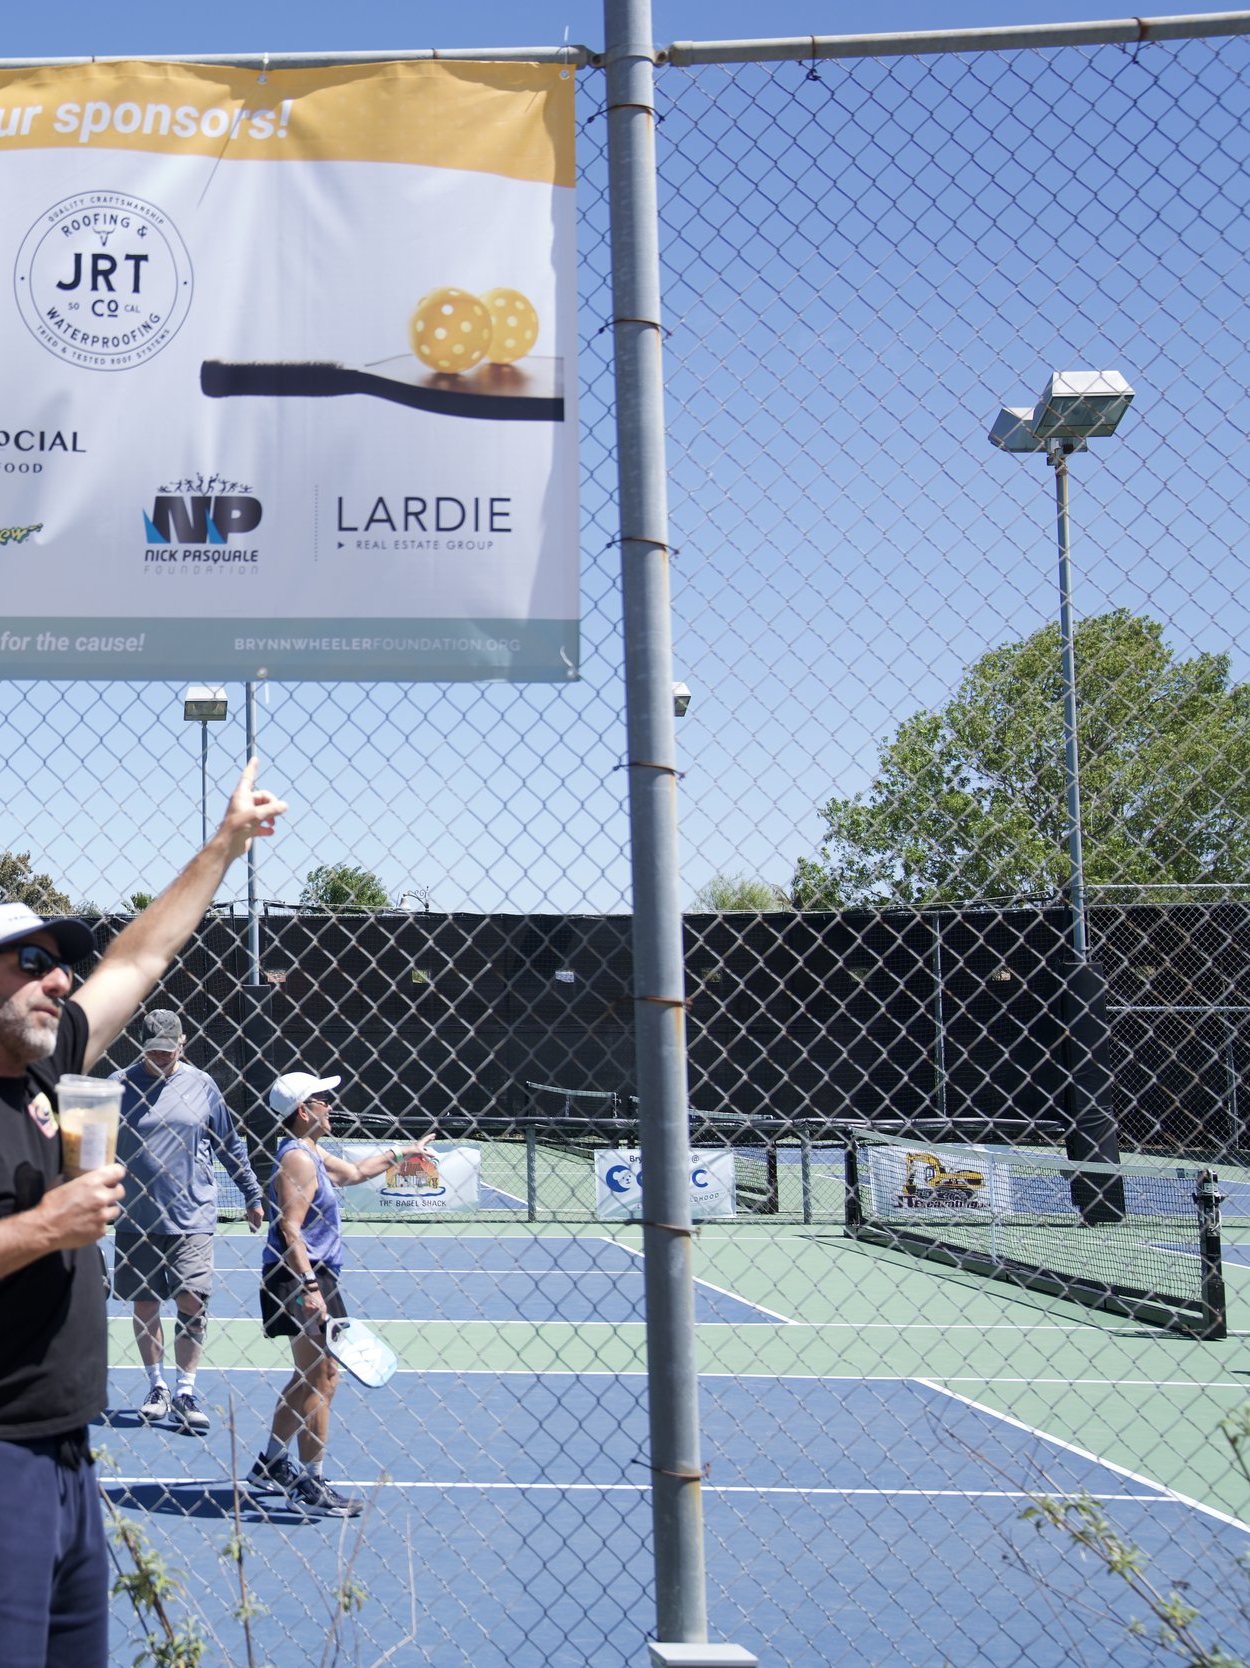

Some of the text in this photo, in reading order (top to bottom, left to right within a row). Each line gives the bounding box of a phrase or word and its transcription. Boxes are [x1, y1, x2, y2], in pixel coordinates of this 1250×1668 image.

[53, 97, 294, 143] sponsors!
[47, 196, 165, 225] QUALITY CRAFTSMANSHIP
[61, 212, 148, 239] ROOFING &
[55, 252, 149, 294] JRT
[67, 302, 80, 311] SO
[124, 304, 141, 313] CAL
[46, 306, 161, 349] WATERPROOFING
[72, 351, 106, 365] TESTED
[142, 495, 263, 545] NP
[337, 496, 512, 532] LARDIE
[144, 549, 259, 564] NICK PASQUALE
[355, 540, 494, 551] REAL ESTATE GROUP
[143, 565, 259, 576] FOUNDATION
[0, 631, 31, 651] for
[36, 632, 70, 652] the
[75, 632, 146, 653] cause!
[234, 638, 521, 652] BRYNNWHEELERFOUNDATION.ORG
[395, 1200, 419, 1208] BAGEL
[421, 1200, 447, 1208] SHACK
